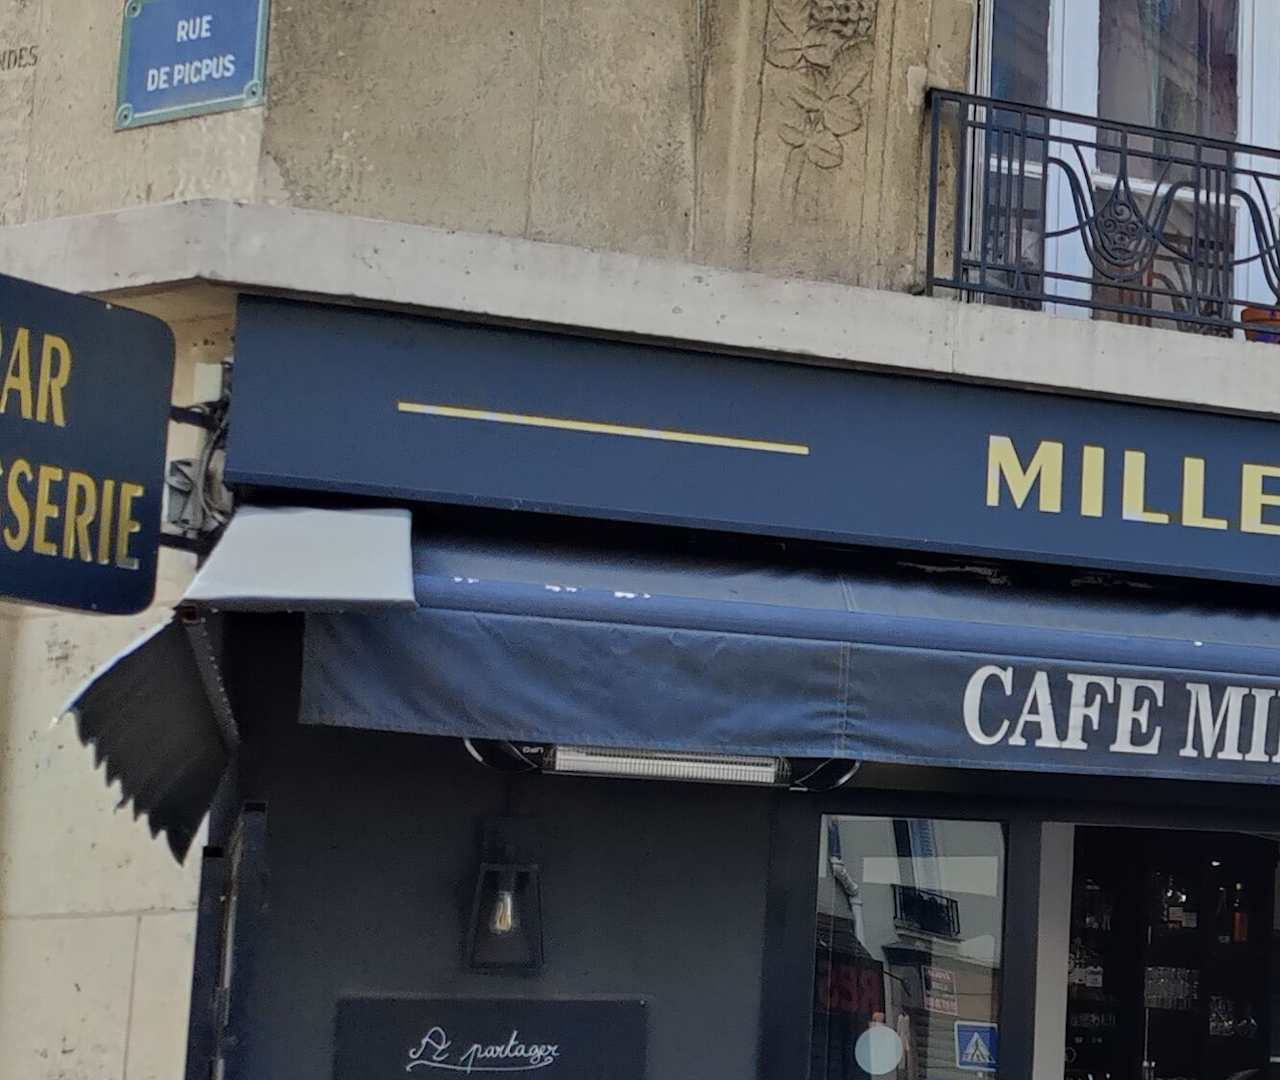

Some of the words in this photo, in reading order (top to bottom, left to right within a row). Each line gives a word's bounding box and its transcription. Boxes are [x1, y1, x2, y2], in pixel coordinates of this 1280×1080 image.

[176, 15, 213, 43] RUE
[146, 66, 171, 92] DE
[172, 54, 236, 88] PICPUS
[0, 327, 72, 427] AR
[0, 458, 144, 571] SERIE
[961, 664, 1166, 757] CAFE
[460, 1030, 561, 1074] partager
